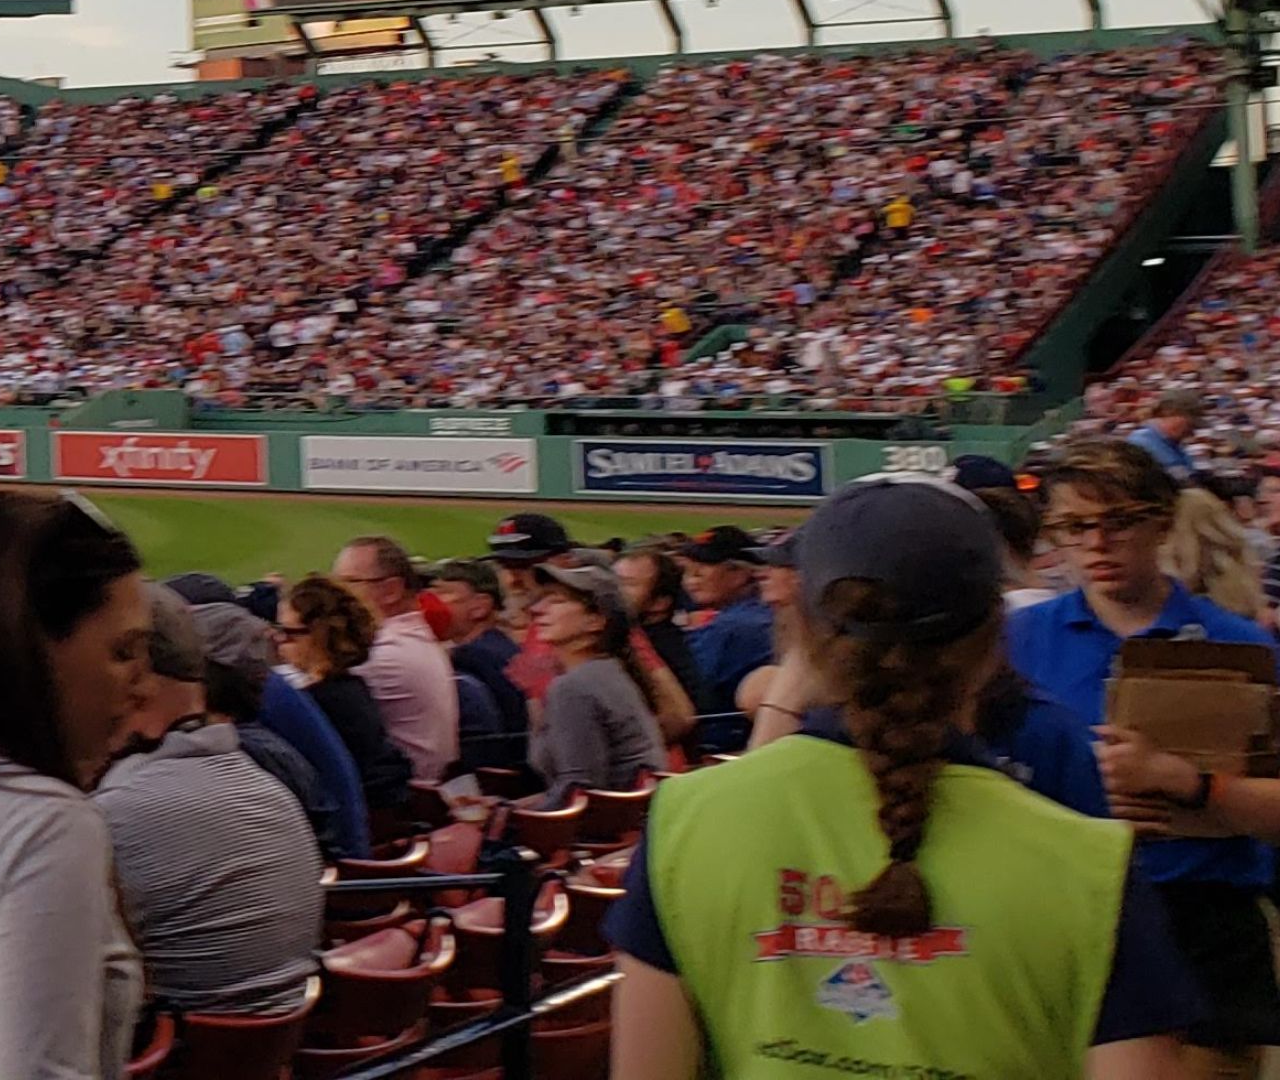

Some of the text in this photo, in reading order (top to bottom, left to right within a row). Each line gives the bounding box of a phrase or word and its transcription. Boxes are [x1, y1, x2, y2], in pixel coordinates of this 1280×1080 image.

[100, 437, 216, 478] xfinity
[309, 457, 482, 472] BANK OF AMERICA
[587, 448, 816, 482] SAMUEL ADAMS
[881, 446, 948, 472] 380
